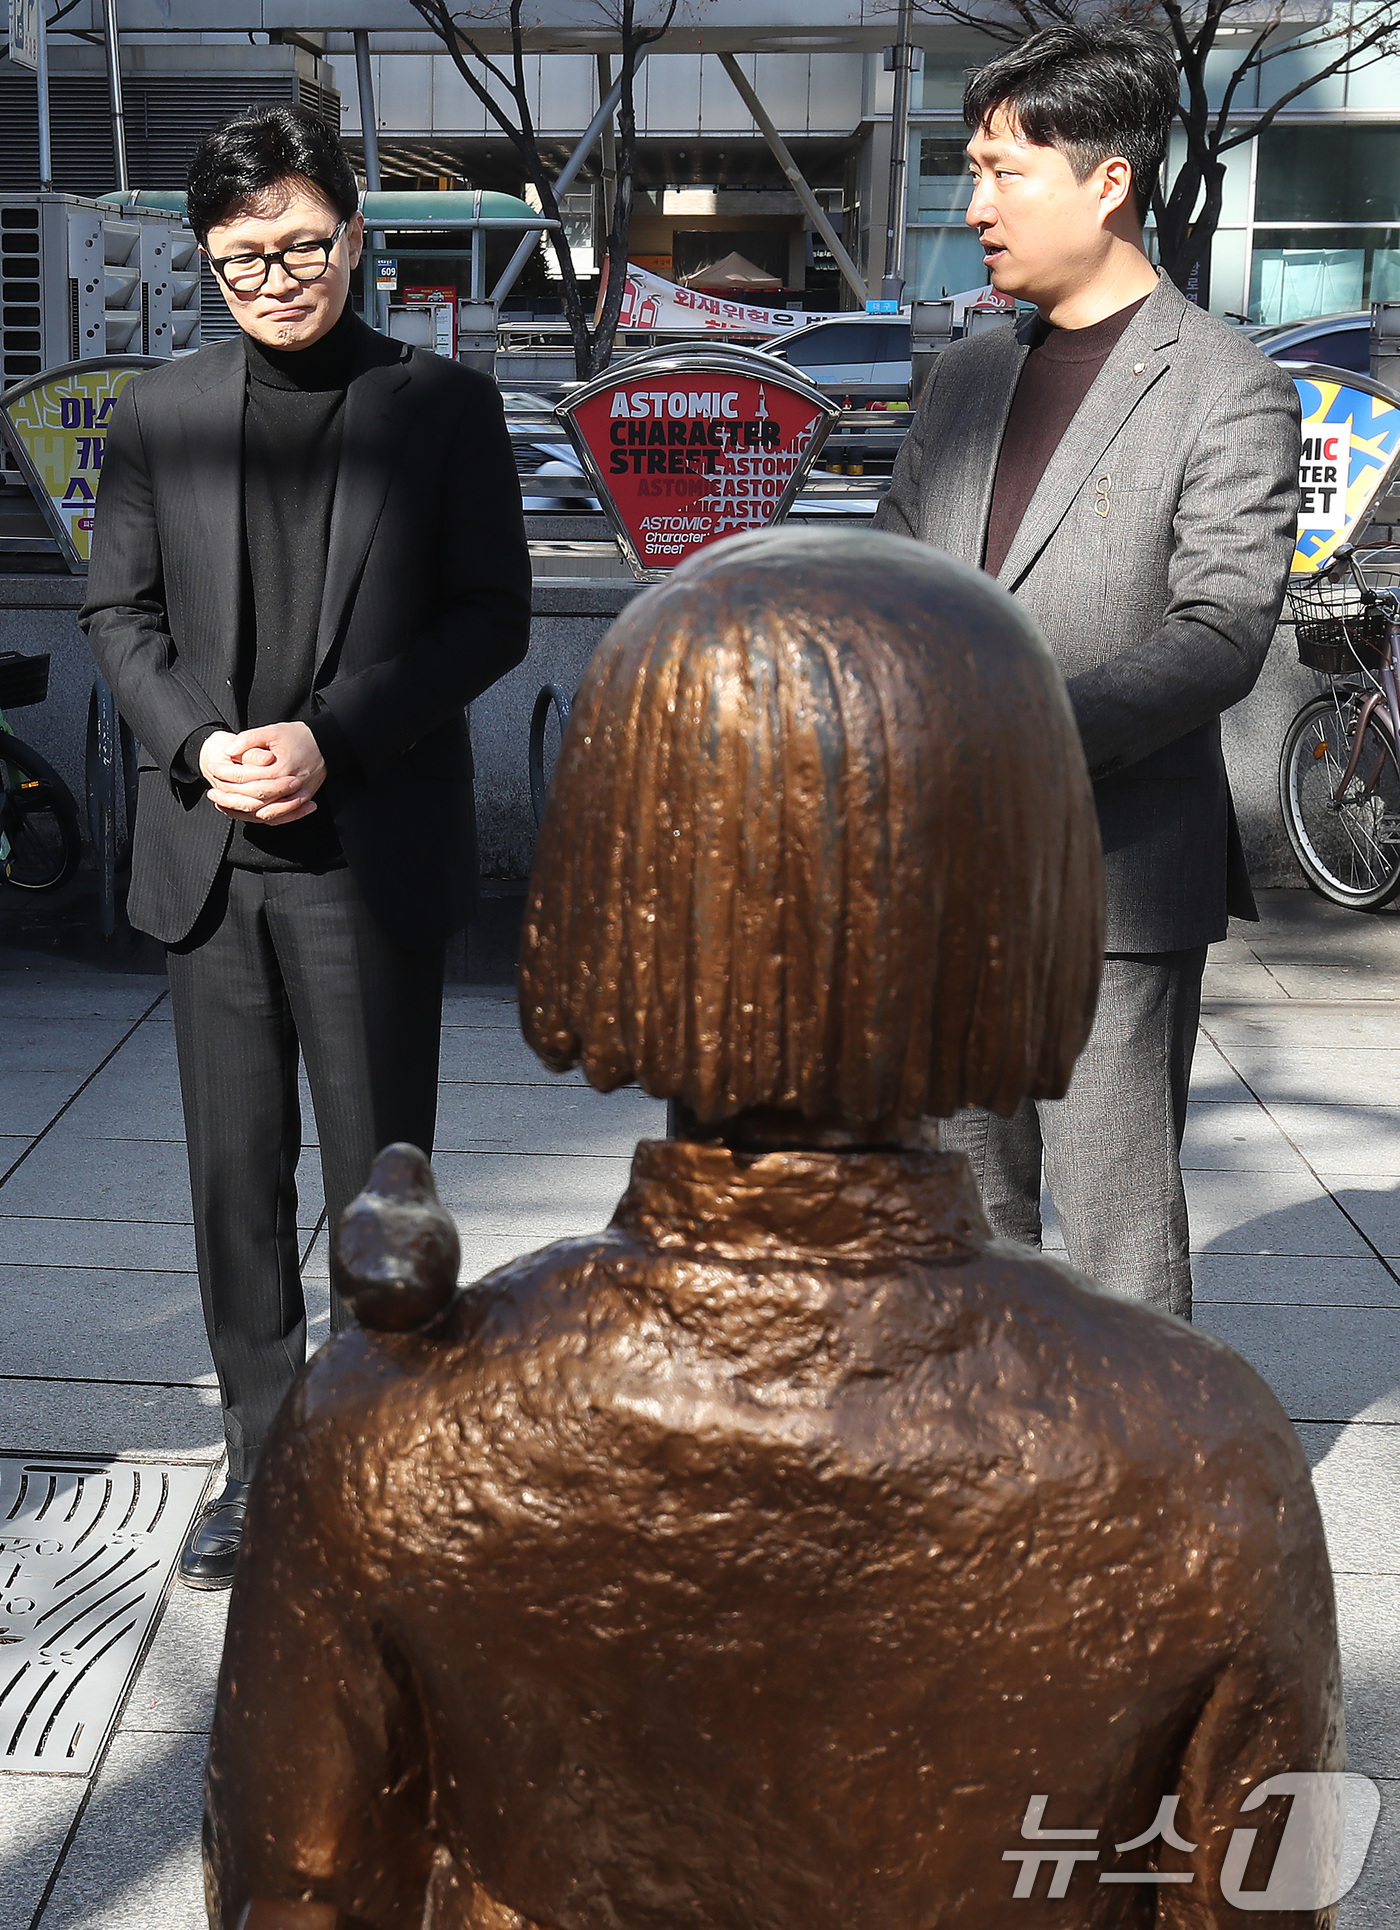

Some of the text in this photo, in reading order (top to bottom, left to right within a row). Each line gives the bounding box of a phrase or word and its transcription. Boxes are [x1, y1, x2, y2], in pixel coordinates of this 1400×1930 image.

[381, 267, 396, 276] 609
[610, 391, 739, 418] ASTOMIC
[610, 421, 780, 446] CHARACTER
[609, 449, 721, 475] STREET
[639, 516, 712, 530] ASTOMIC
[645, 532, 706, 543] Character
[645, 543, 685, 554] Street
